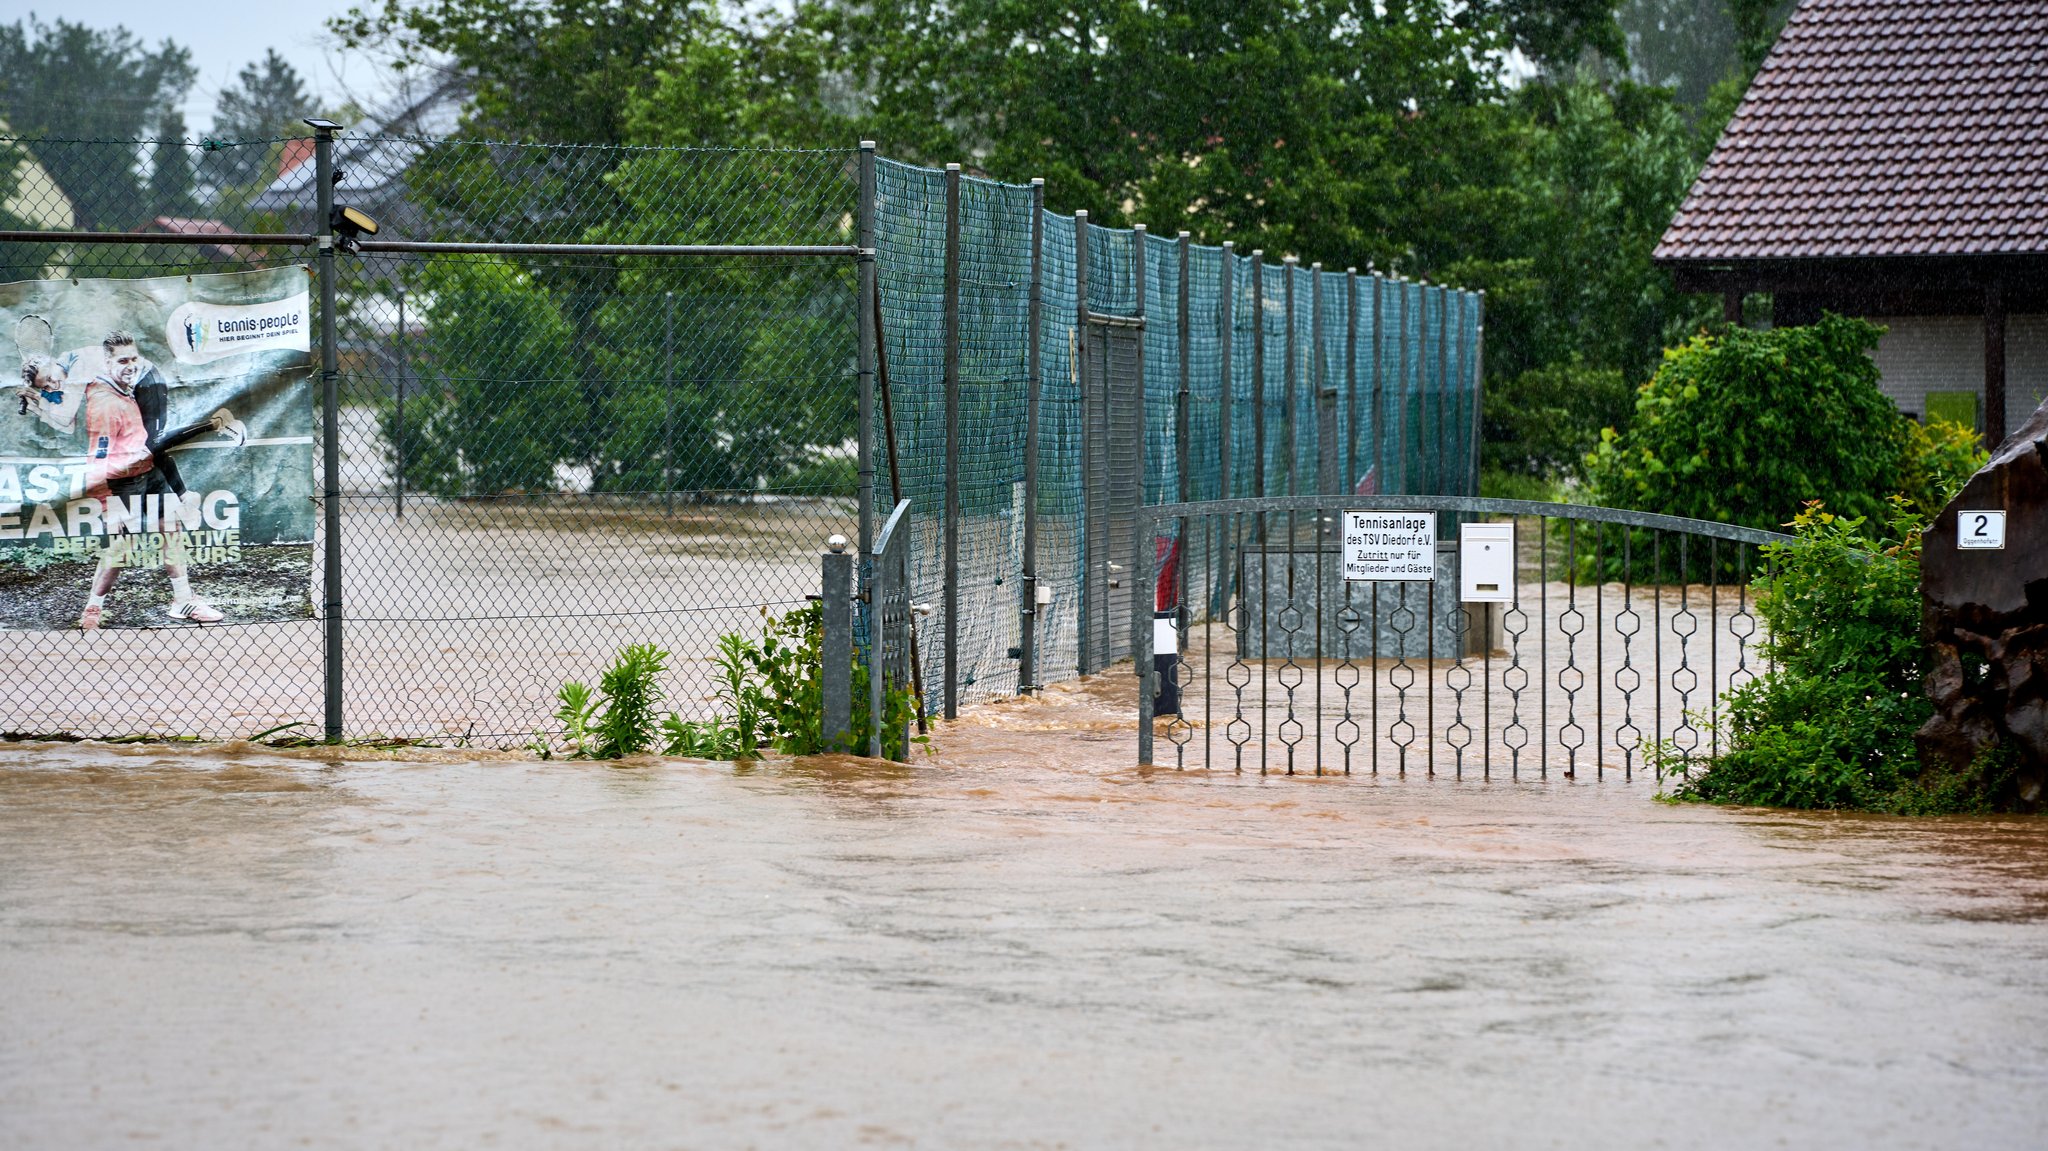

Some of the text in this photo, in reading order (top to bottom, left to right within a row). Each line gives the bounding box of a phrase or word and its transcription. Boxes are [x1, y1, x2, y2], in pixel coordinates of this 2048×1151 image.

[236, 333, 265, 341] BEGINNT
[266, 330, 281, 338] DEIN
[281, 328, 299, 336] SPIEL
[1353, 515, 1426, 533] Tennisanlage
[1974, 514, 1988, 537] 2
[1346, 533, 1432, 546] des TSV Diedorf e.V.
[1357, 549, 1421, 560] Zutritt nur für
[1346, 563, 1432, 575] Mitglieder und Gäste
